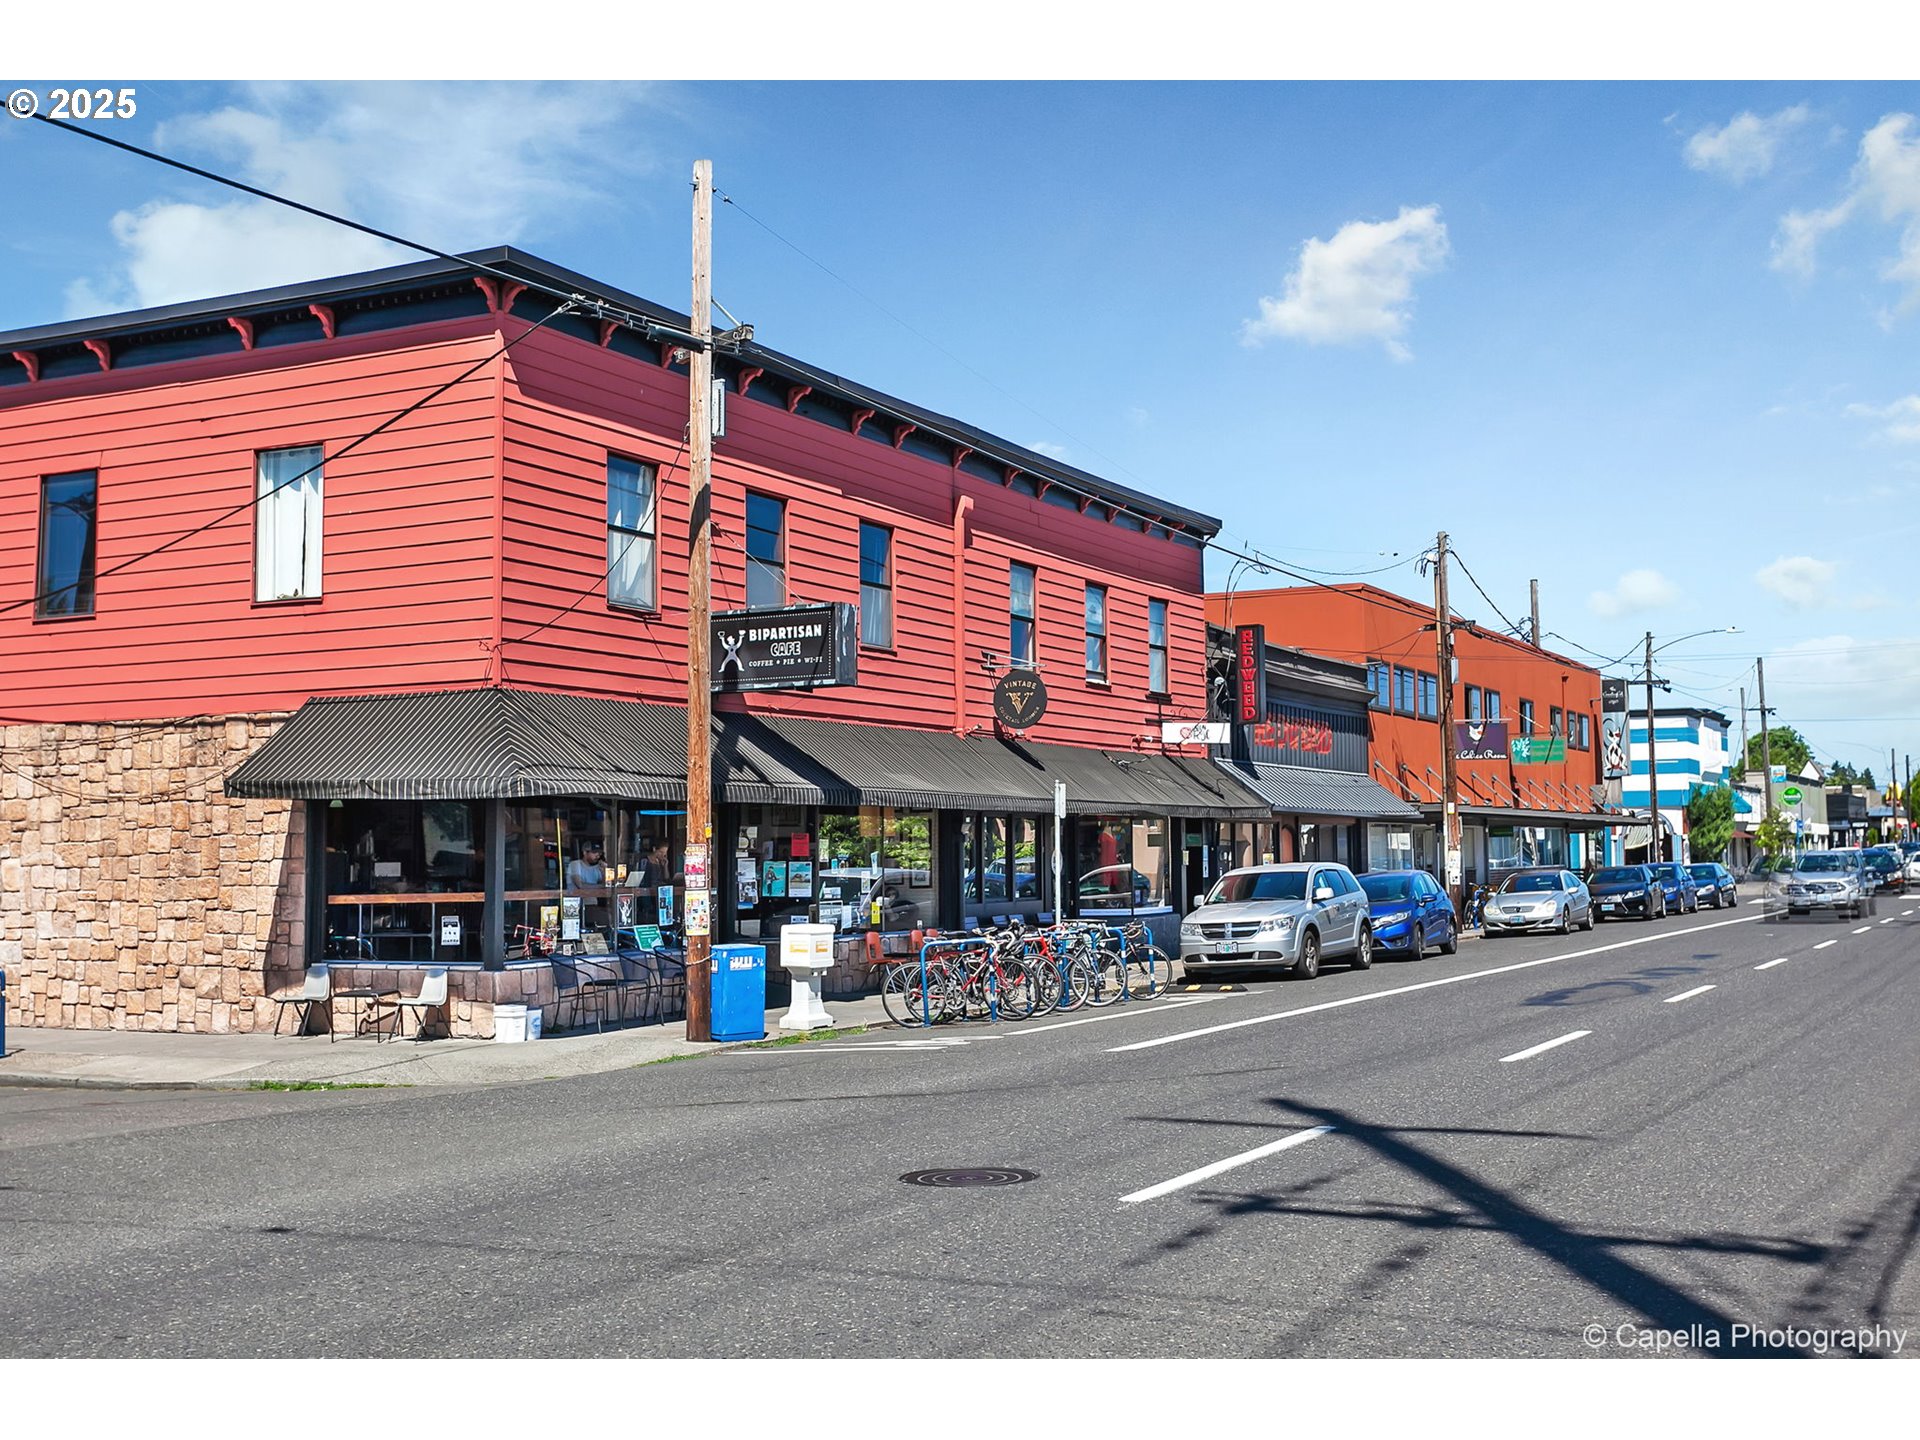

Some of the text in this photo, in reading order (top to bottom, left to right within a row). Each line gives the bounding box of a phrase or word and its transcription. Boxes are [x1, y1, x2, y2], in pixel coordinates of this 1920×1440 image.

[748, 624, 822, 641] BIPARTISAN
[770, 641, 802, 656] CAFE
[748, 659, 774, 667] COFFEE
[803, 656, 823, 664] WI-FI
[1240, 629, 1256, 720] REDWOOD
[1003, 680, 1037, 690] VINTAGE
